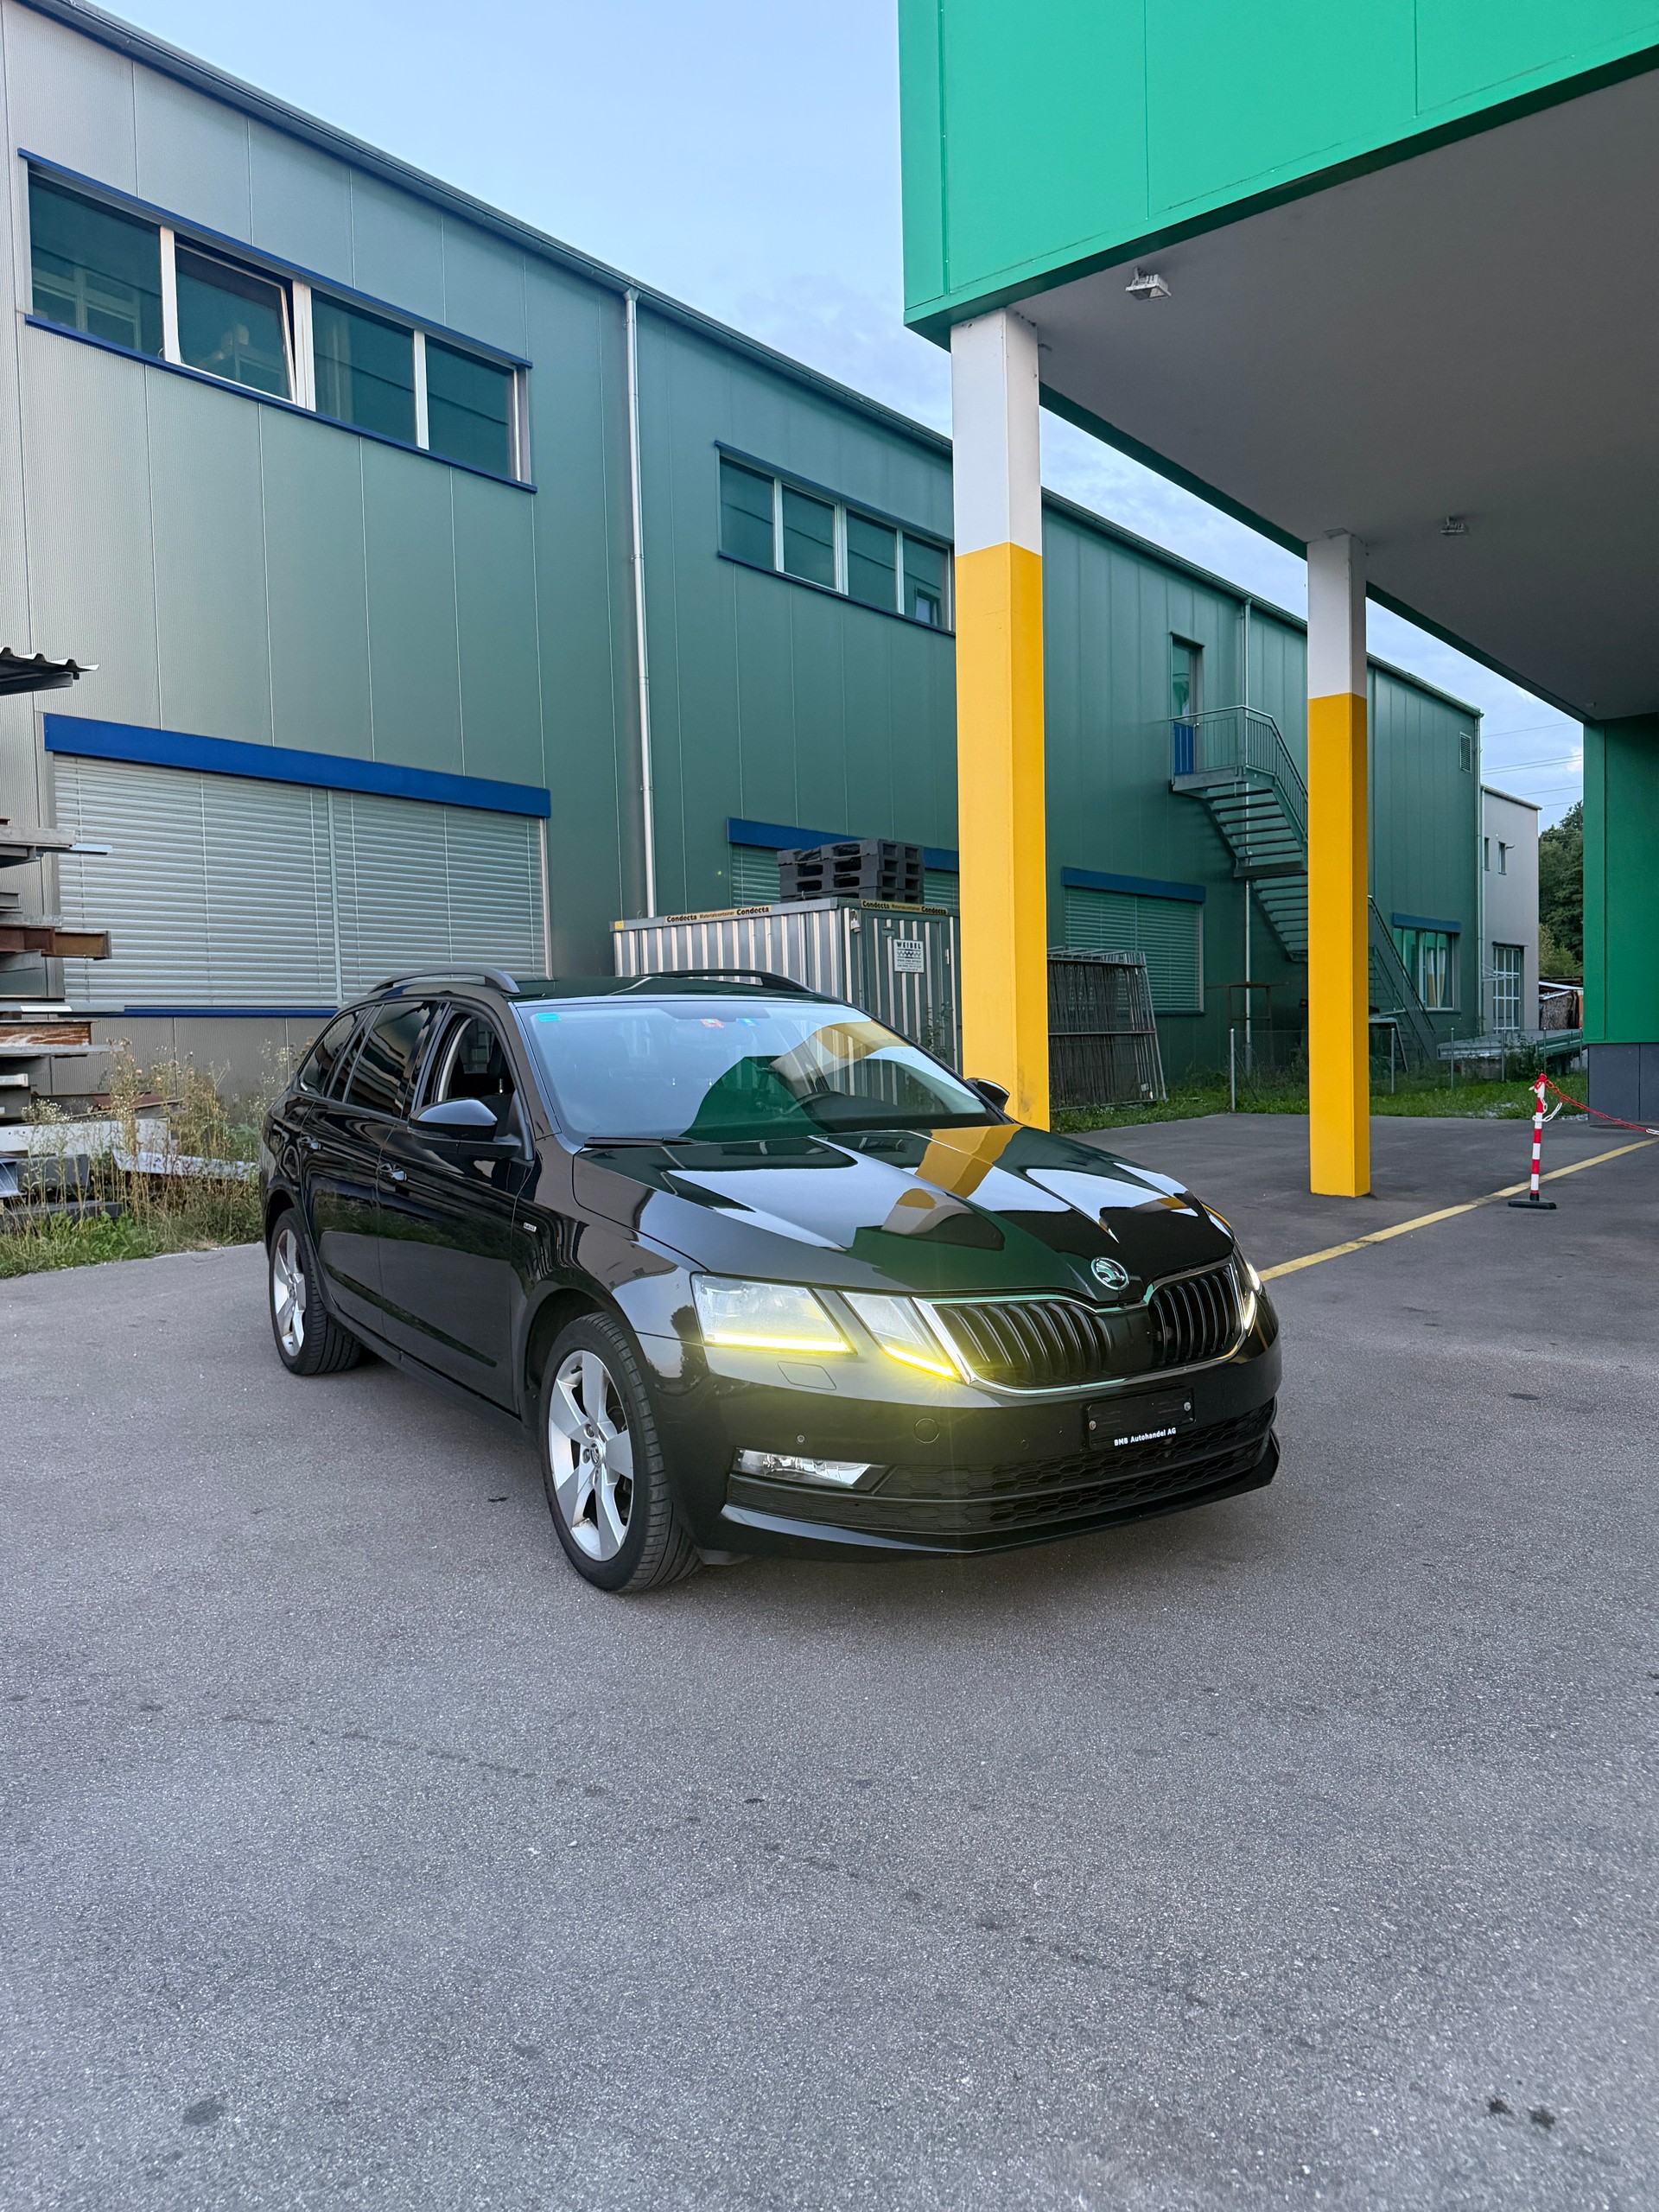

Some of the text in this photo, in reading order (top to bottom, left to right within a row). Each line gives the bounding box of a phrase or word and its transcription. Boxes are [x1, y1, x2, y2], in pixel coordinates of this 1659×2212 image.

[862, 900, 890, 910] Condecta
[666, 914, 697, 923] Condecta
[736, 906, 770, 916] Condecta
[896, 941, 921, 950] WEIBEL
[1114, 1427, 1177, 1446] BMB Autohandel AG
